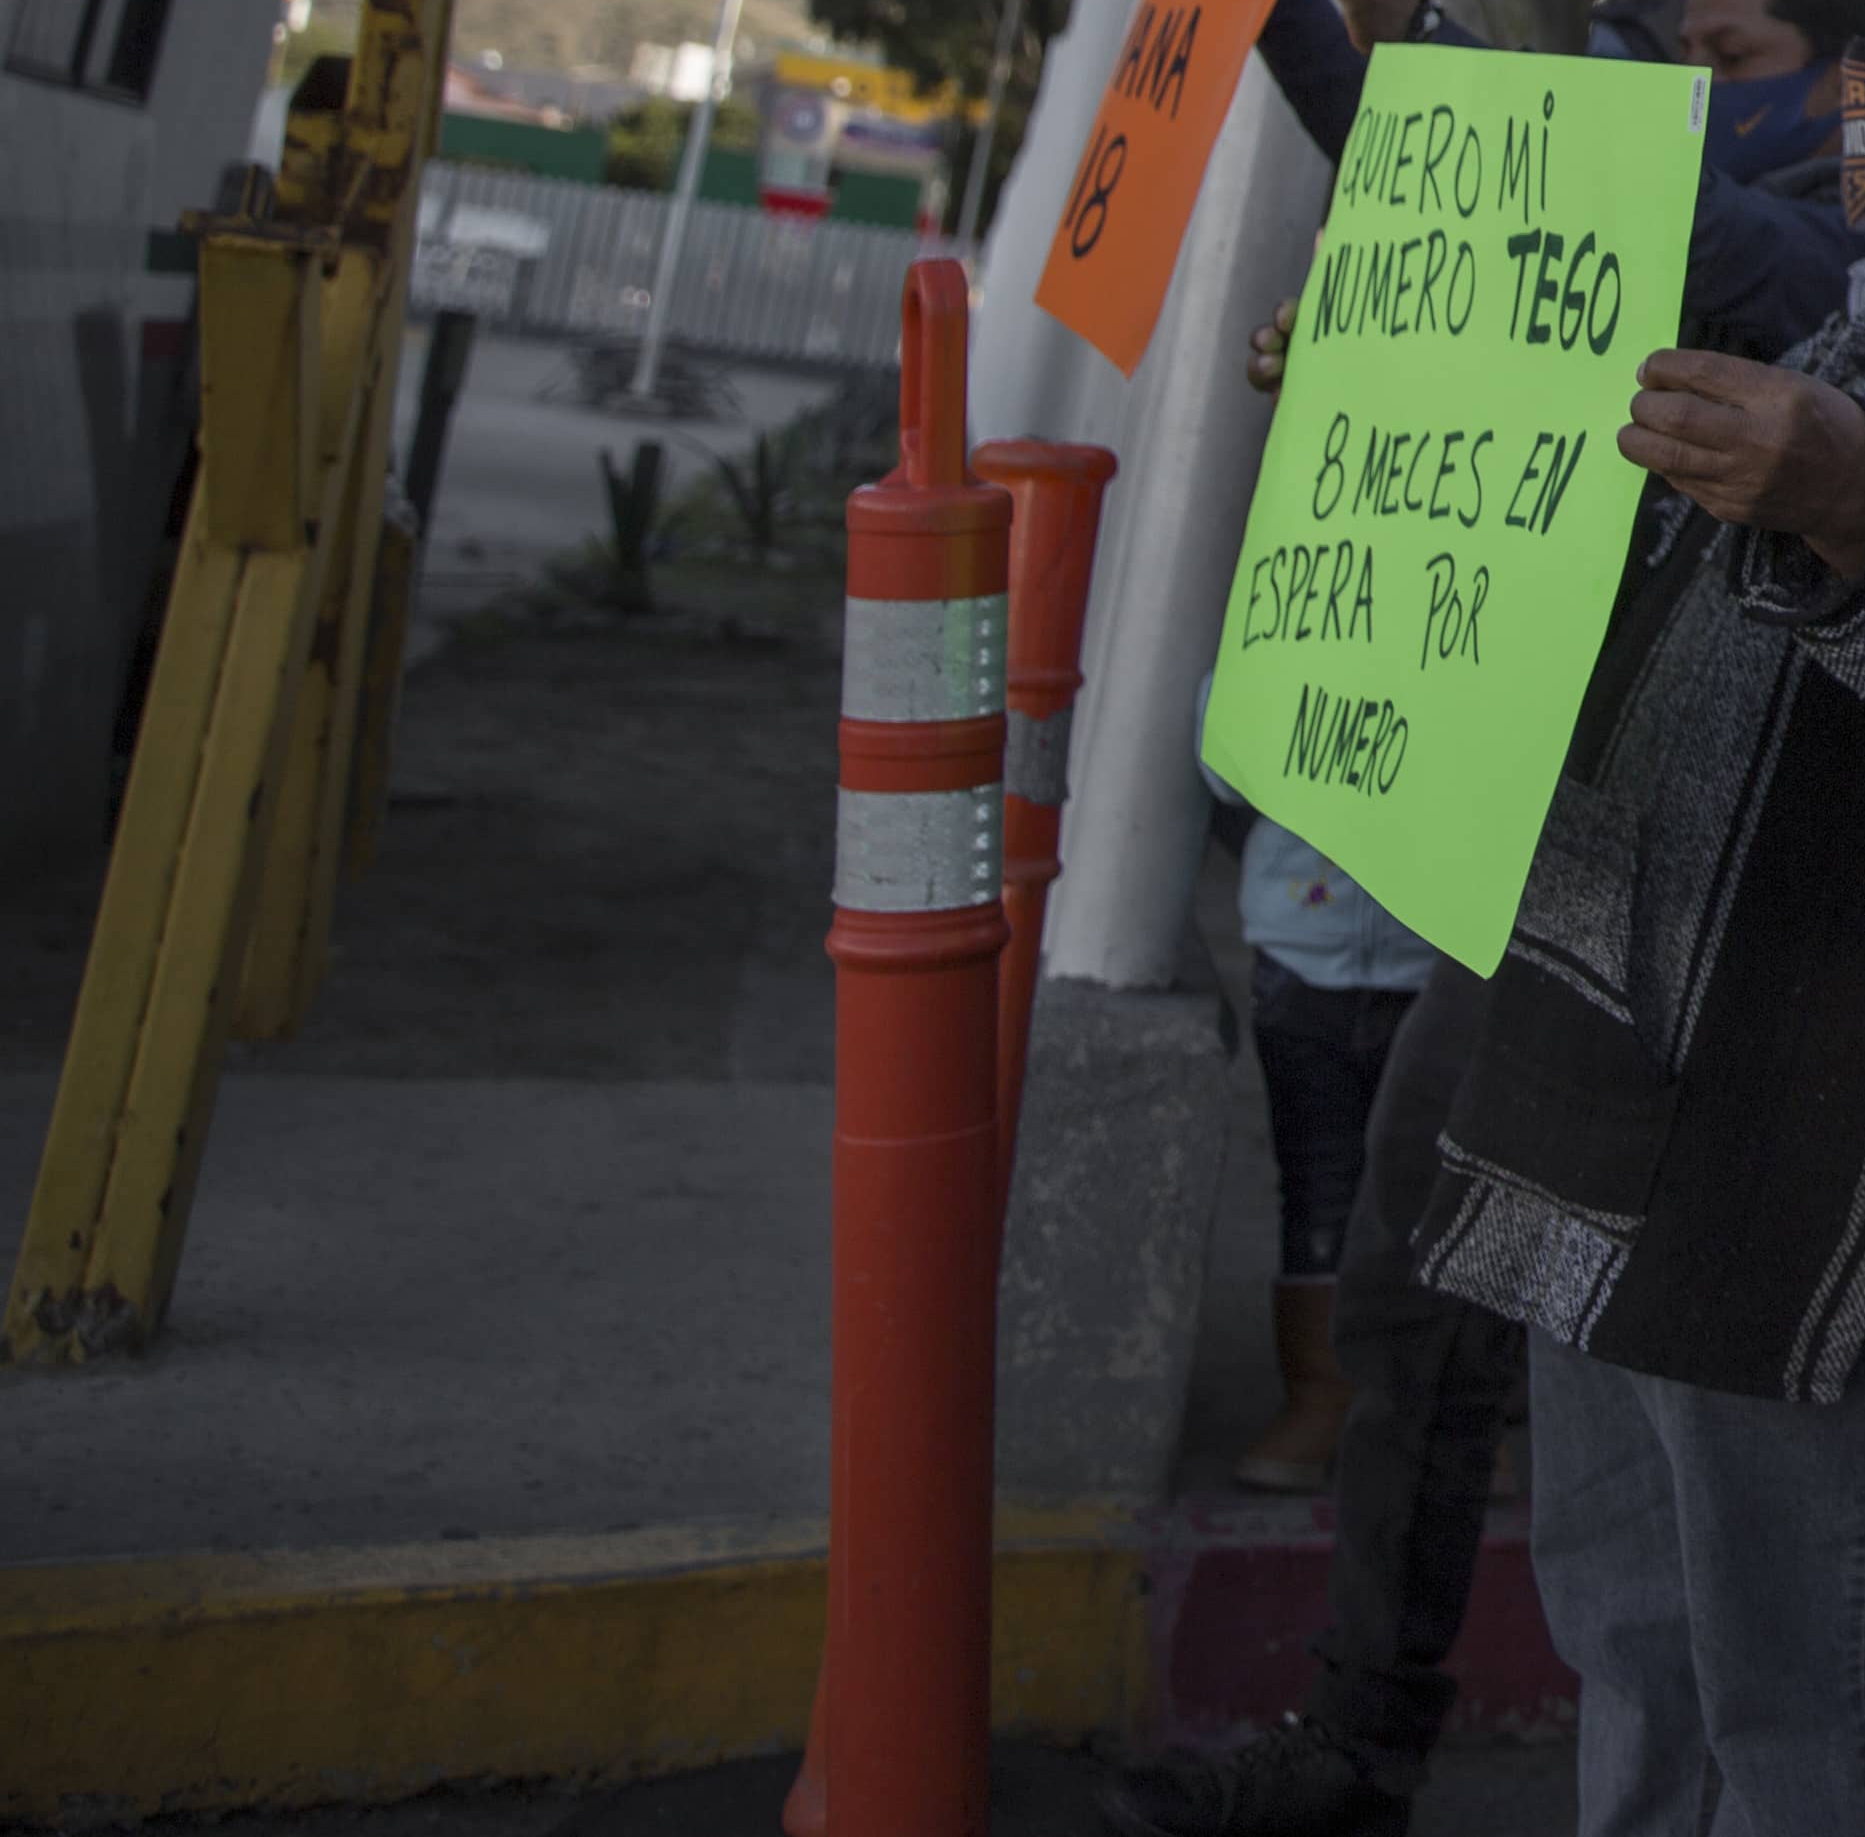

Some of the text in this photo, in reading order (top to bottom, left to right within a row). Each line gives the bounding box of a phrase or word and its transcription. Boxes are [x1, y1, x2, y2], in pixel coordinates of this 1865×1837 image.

[1113, 4, 1202, 121] ANA
[1064, 123, 1128, 260] 18
[1341, 104, 1482, 219] QUIERO
[1313, 227, 1621, 355] NUMERO TEGO
[1313, 412, 1586, 535] 8 MECES EN
[1243, 540, 1372, 649] ESPERA
[1284, 684, 1408, 795] NUMERO
